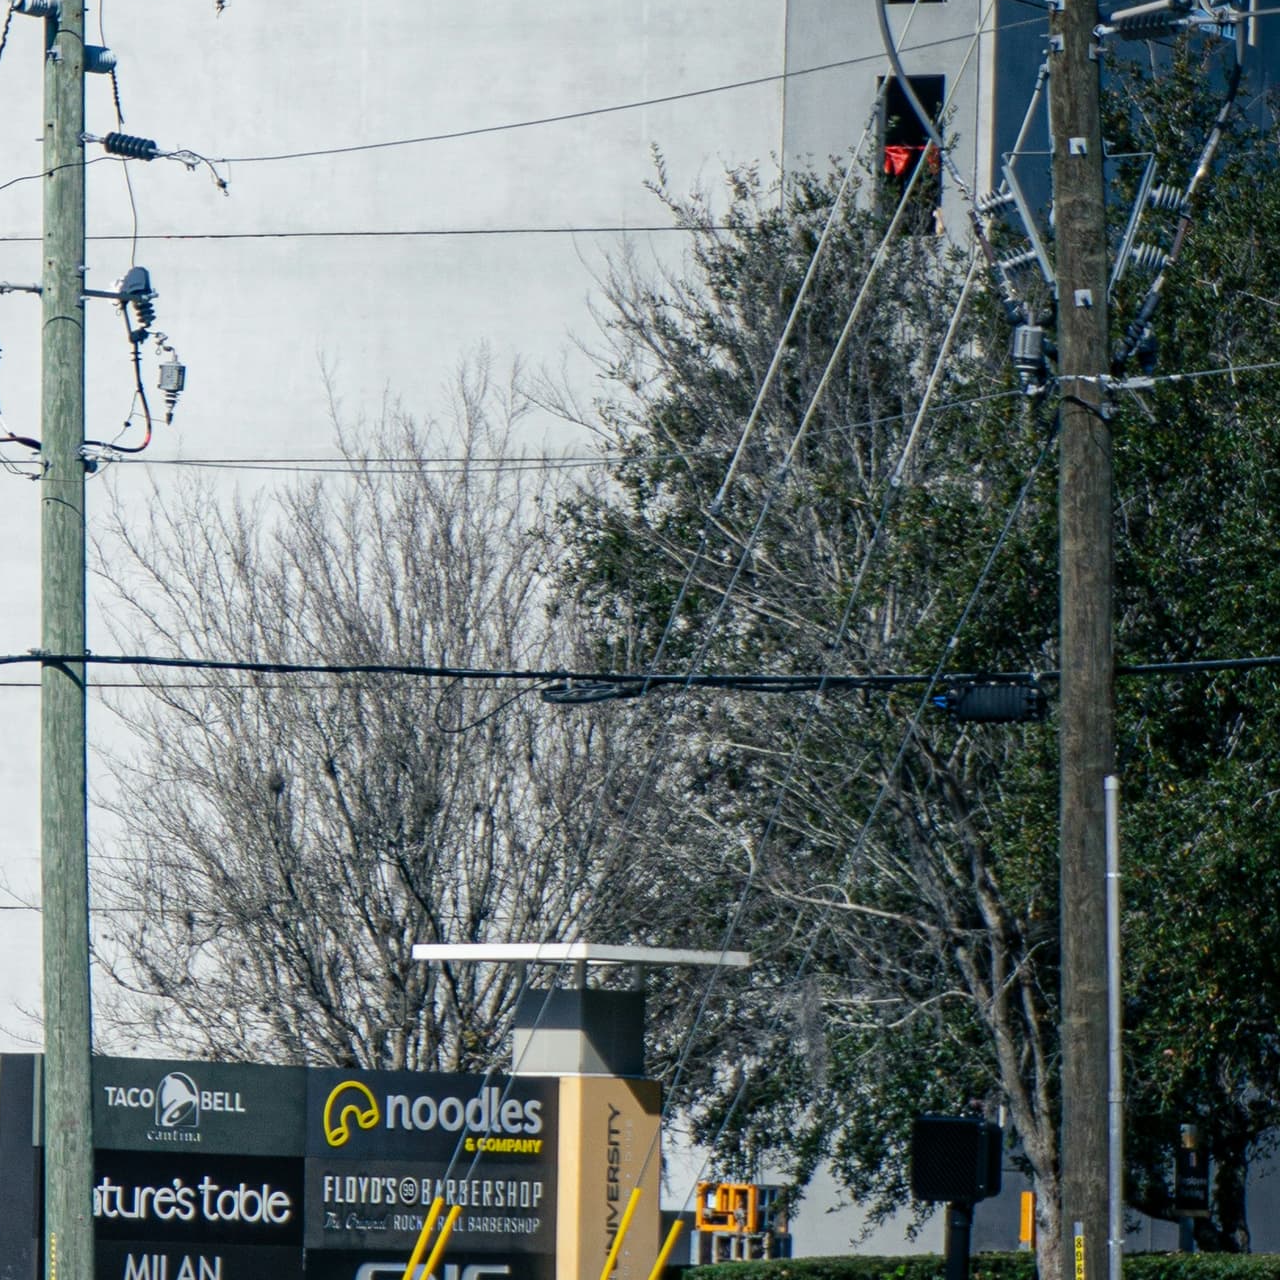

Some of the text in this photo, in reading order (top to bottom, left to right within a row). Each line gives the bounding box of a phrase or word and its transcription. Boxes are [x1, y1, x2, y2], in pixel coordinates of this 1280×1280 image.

[104, 1086, 246, 1113] TACO BELL
[386, 1086, 543, 1135] noodles
[464, 1137, 543, 1154] & COMPANY
[198, 1176, 291, 1223] table
[323, 1176, 397, 1206] FLOYD'S
[437, 1216, 464, 1232] RLL
[467, 1216, 541, 1234] BARBERSHOP
